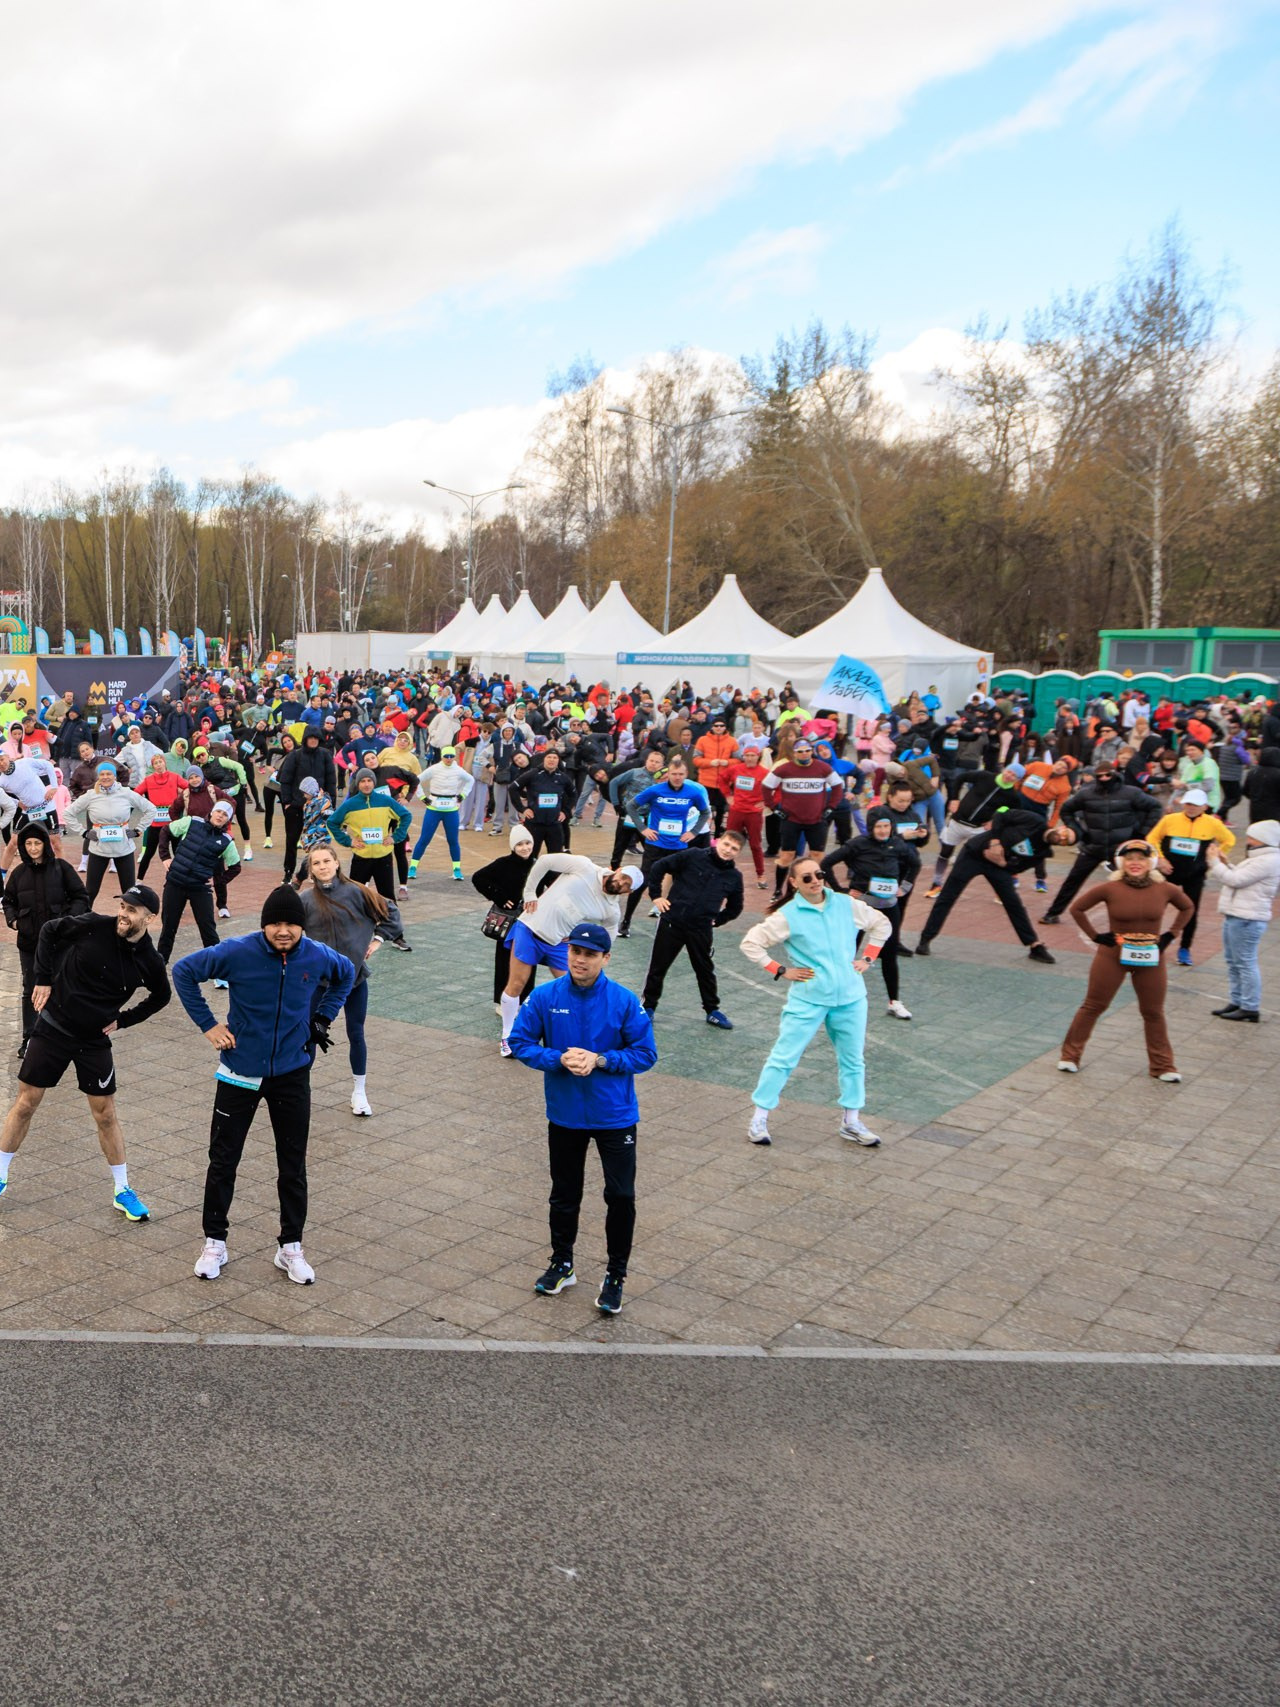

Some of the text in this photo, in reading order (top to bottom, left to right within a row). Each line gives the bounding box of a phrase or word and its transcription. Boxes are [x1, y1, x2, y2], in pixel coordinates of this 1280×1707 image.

[634, 655, 672, 663] ЖЕНСКАЯ
[108, 681, 127, 689] HARD
[108, 689, 123, 697] RUN
[878, 884, 892, 892] 225
[1130, 951, 1151, 960] 820
